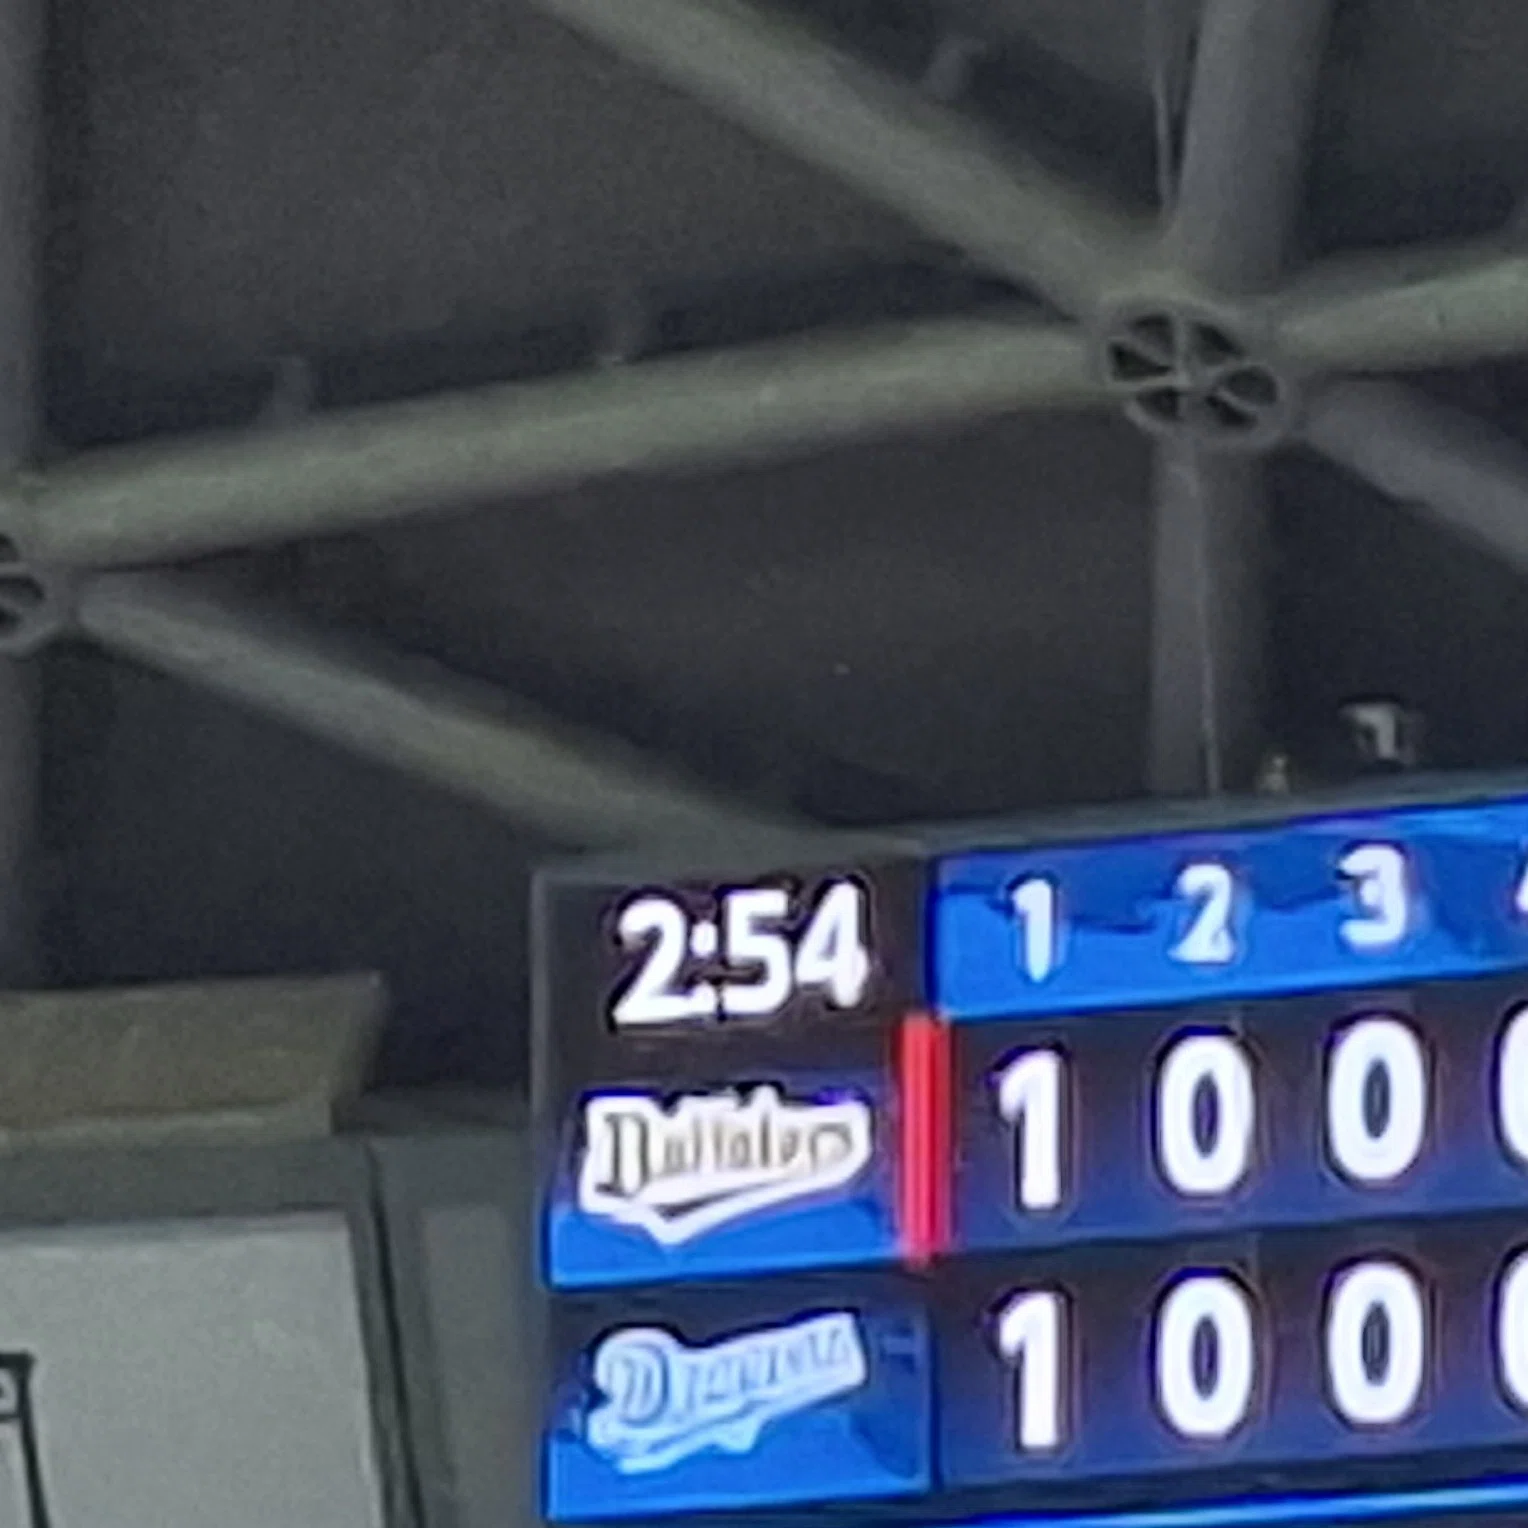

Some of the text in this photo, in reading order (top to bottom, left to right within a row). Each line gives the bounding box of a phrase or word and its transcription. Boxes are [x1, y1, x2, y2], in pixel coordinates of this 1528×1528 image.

[612, 882, 870, 1024] 2:54
[1011, 878, 1055, 982] 1
[1170, 863, 1236, 963] 2
[1338, 843, 1409, 948] 3
[999, 1050, 1059, 1209] 1
[1158, 1035, 1254, 1194] 0
[1327, 1019, 1426, 1181] 0
[999, 1291, 1059, 1449] 1
[1157, 1277, 1253, 1437] 0
[1327, 1262, 1424, 1424] 0
